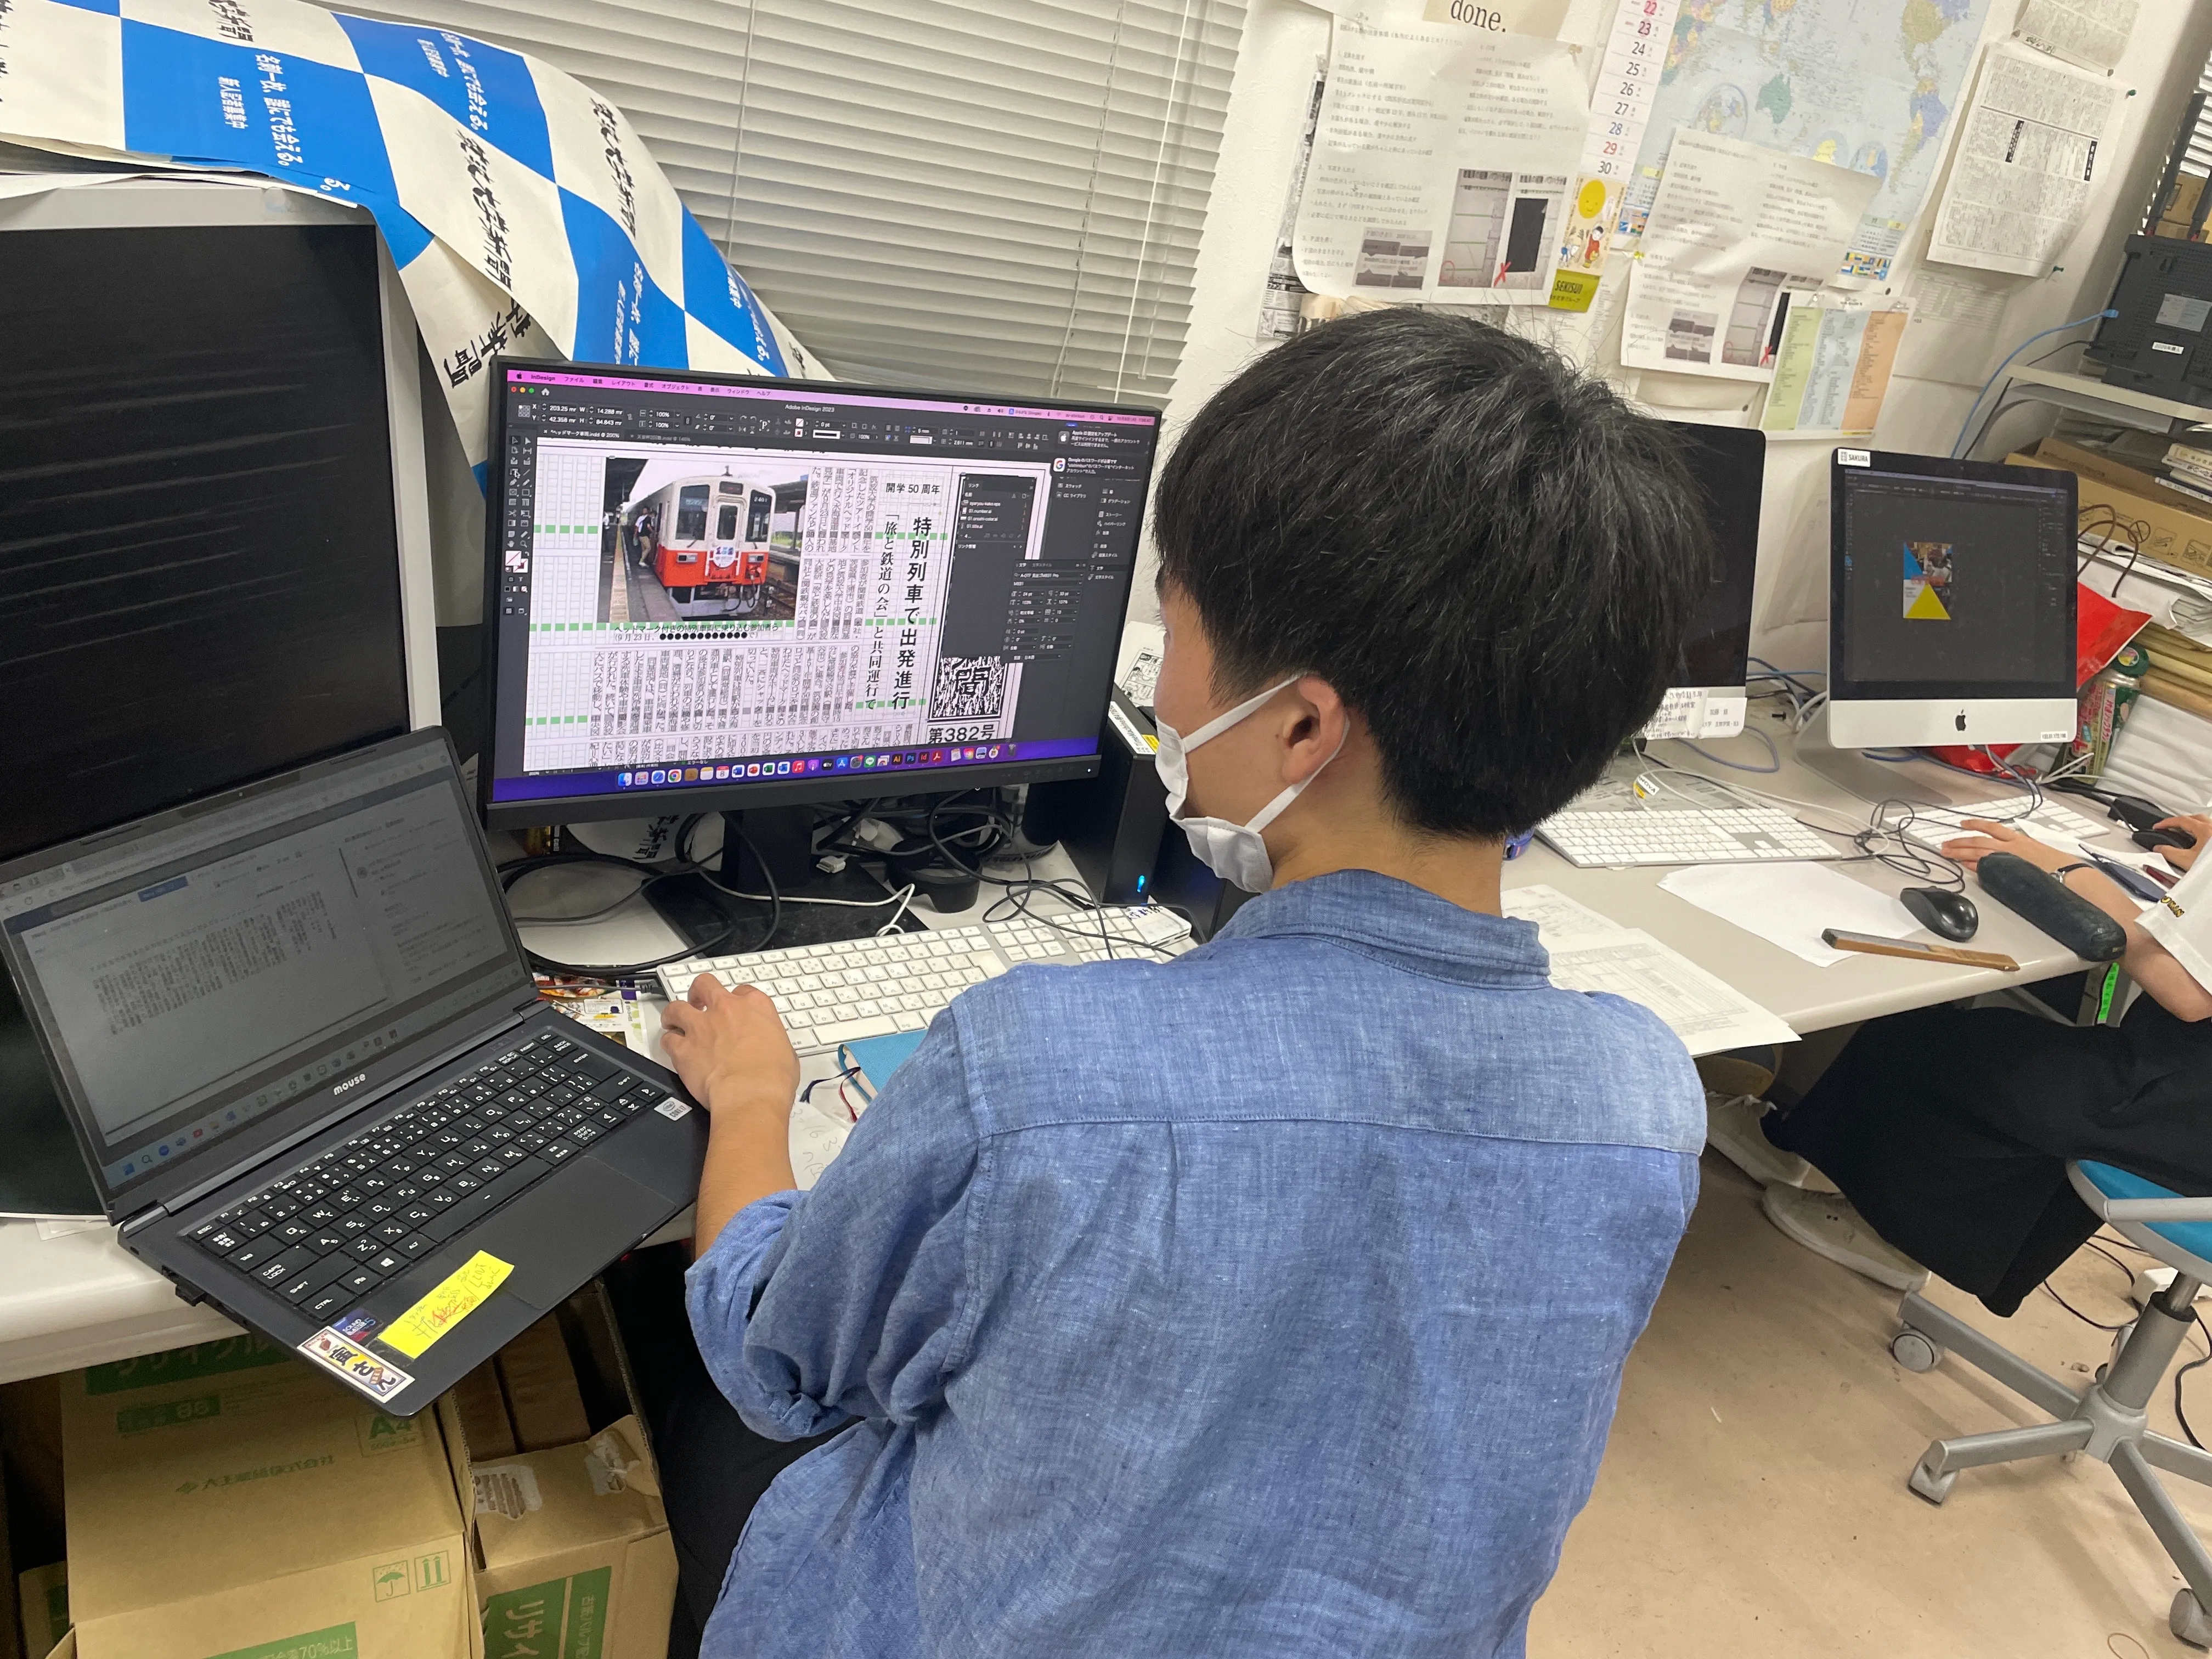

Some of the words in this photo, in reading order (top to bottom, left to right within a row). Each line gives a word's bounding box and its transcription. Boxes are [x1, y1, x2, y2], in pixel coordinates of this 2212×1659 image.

[1644, 1, 1657, 15] 22
[1451, 0, 1506, 32] done.
[1638, 20, 1651, 36] 23
[1632, 41, 1645, 56] 24
[1626, 61, 1640, 76] 25
[1620, 82, 1634, 96] 26
[1615, 101, 1629, 115] 27
[1609, 121, 1623, 136] 28
[1603, 141, 1617, 156] 29
[1598, 161, 1612, 175] 30
[1554, 280, 1583, 294] SEKISUI
[1848, 454, 1869, 462] SAKURA
[865, 514, 900, 710] 「旅と鉄道の会」と共同運行で
[891, 516, 932, 710] 特別列車で出発進行
[928, 724, 995, 744] 第382号
[333, 1072, 366, 1096] mouse
[504, 1150, 516, 1158] M
[481, 1165, 493, 1173] N
[398, 1189, 407, 1197] F
[313, 1210, 325, 1218] W
[372, 1204, 383, 1212] D
[197, 1225, 212, 1234] ESC
[346, 1221, 357, 1229] S
[357, 1243, 369, 1252] Z
[262, 1264, 282, 1276] CAPS
[267, 1267, 286, 1279] LOCK
[314, 1299, 333, 1310] CTRL
[342, 1318, 362, 1333] SOUND
